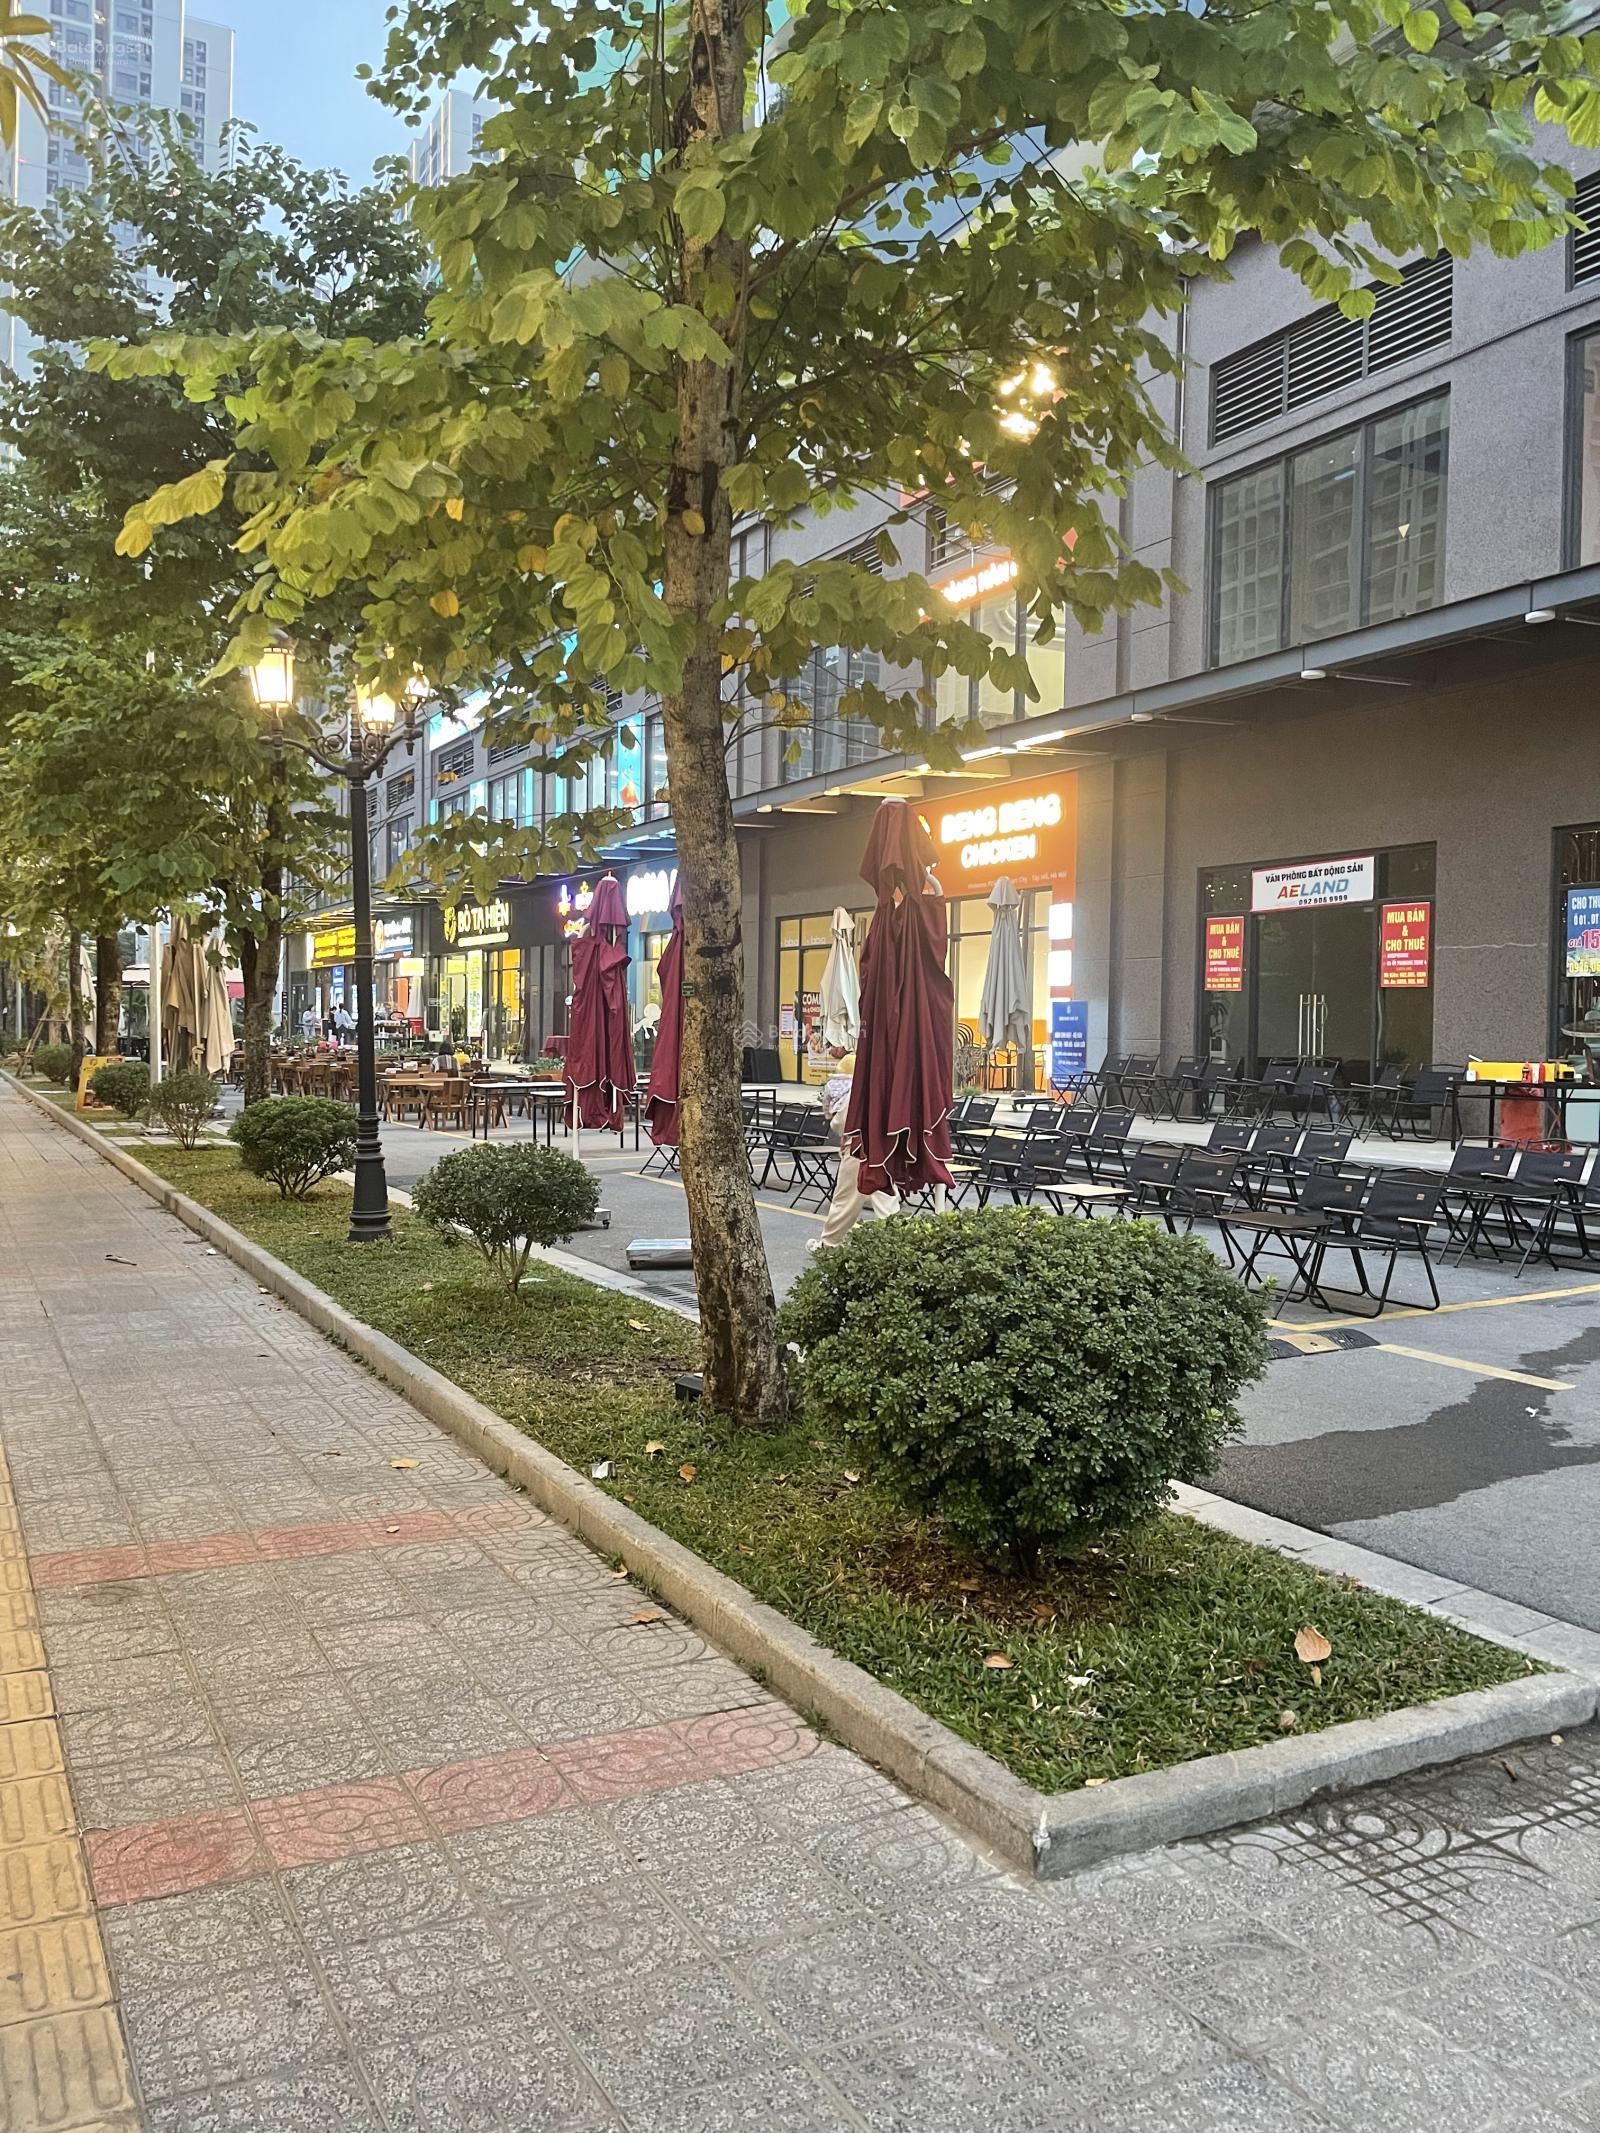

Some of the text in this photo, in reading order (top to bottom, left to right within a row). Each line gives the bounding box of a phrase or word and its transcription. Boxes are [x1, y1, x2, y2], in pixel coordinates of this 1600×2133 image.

[961, 834, 1036, 868] CHICKEN
[1281, 868, 1307, 882] PHÒNG
[1347, 862, 1363, 872] SẢN
[1277, 879, 1349, 899] AELAND
[1572, 896, 1587, 910] CHO
[458, 898, 509, 934] BÒ TẠ HIỆN
[1387, 908, 1424, 924] MUA BÁN
[1210, 922, 1239, 934] MUA BÁN
[1402, 925, 1408, 936] &
[1386, 936, 1425, 951] CHO THUÊ
[1209, 946, 1240, 959] CHO THUÊ
[803, 993, 820, 1005] COM
